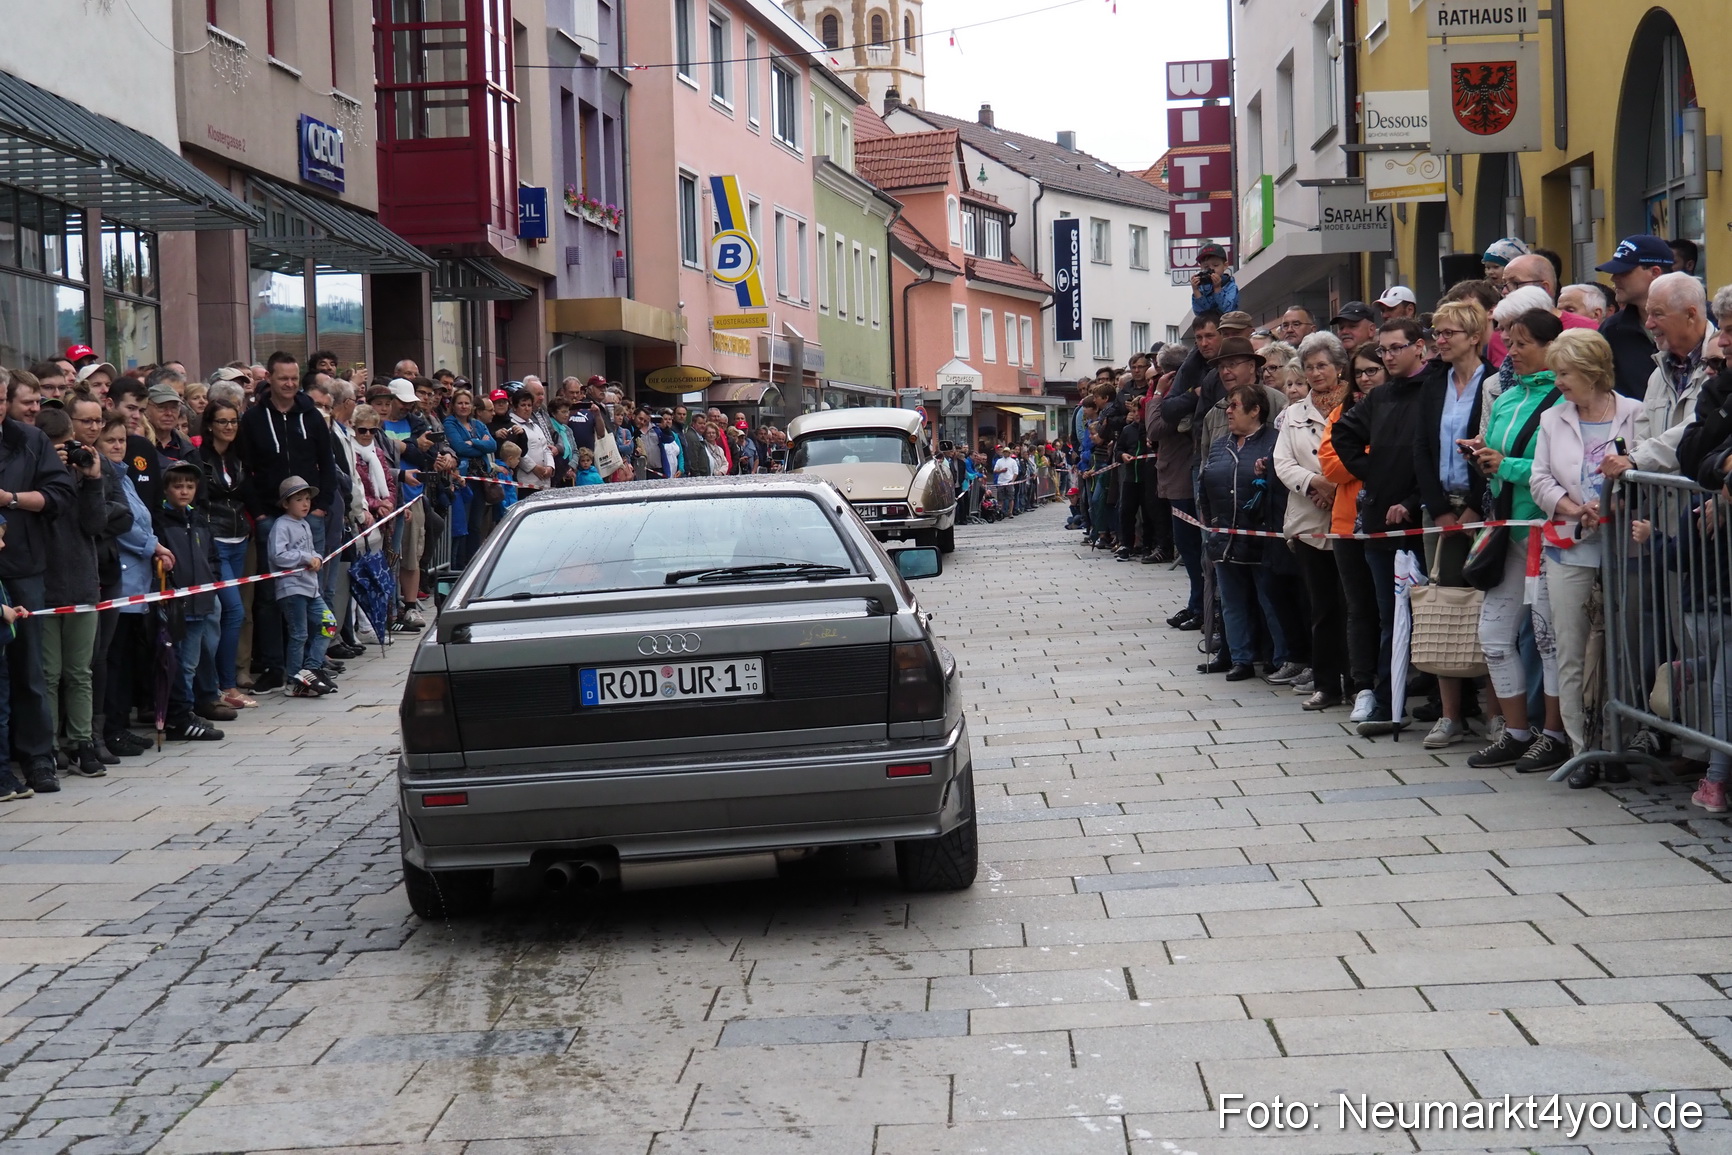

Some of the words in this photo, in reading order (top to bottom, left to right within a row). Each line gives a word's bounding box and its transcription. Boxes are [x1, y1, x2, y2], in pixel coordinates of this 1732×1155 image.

[1438, 8, 1513, 26] RATHAUS
[1518, 7, 1527, 23] II
[1367, 110, 1428, 129] Dessous
[207, 124, 241, 151] Klostergasse
[242, 138, 246, 152] 2
[308, 123, 344, 169] CECIL
[1169, 63, 1213, 235] WITT
[1373, 190, 1396, 199] Endlich
[1324, 206, 1372, 223] SARAH
[1377, 206, 1387, 222] K
[1352, 222, 1388, 230] LIFESTYLE
[718, 243, 742, 269] B
[1071, 229, 1079, 287] TAILOR
[327, 294, 354, 324] CECIL
[744, 663, 756, 672] 04
[599, 670, 657, 700] ROD
[678, 666, 715, 695] UR
[724, 664, 742, 692] 1
[746, 682, 758, 691] 10
[586, 690, 594, 700] D
